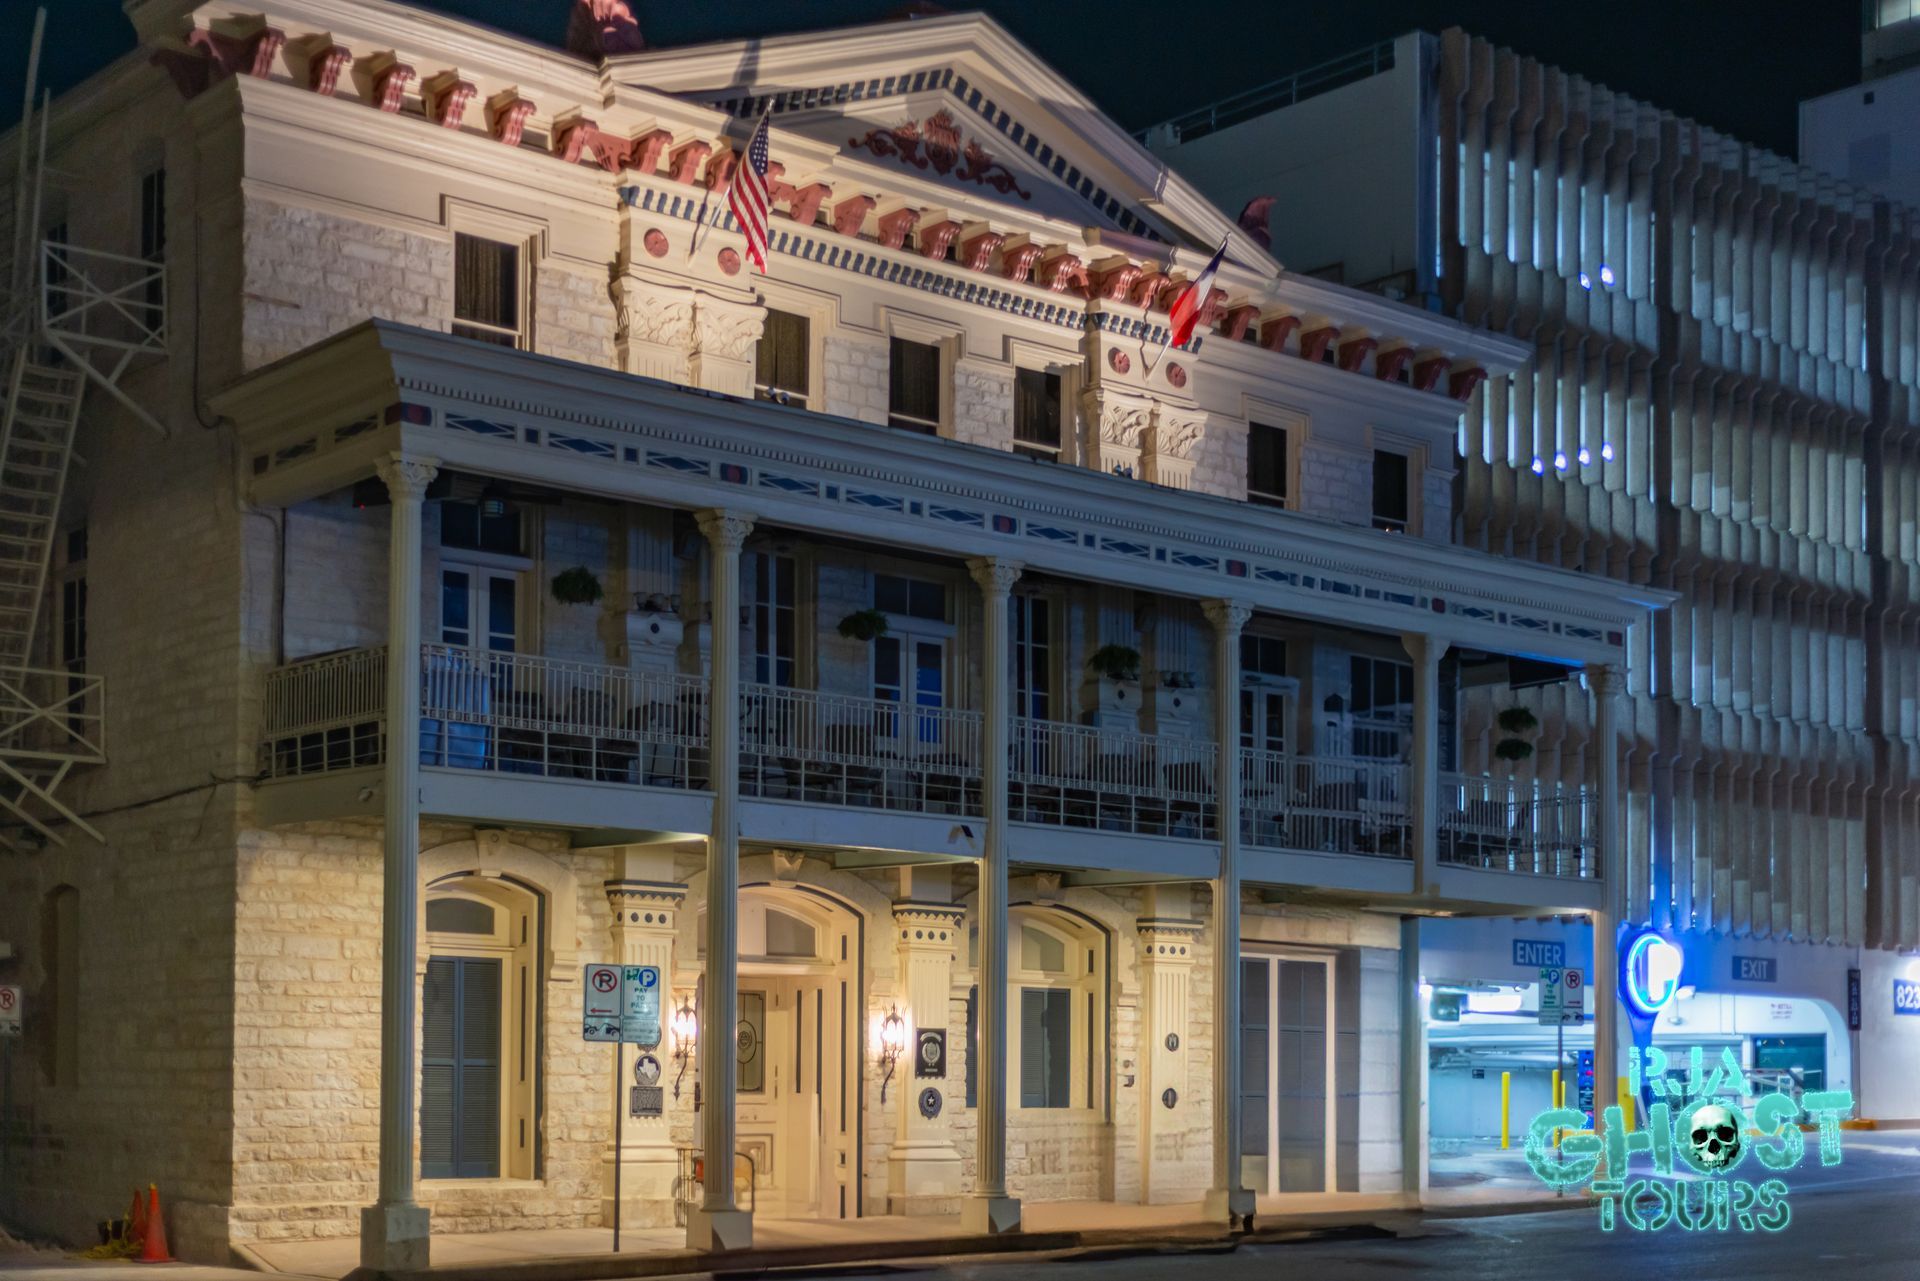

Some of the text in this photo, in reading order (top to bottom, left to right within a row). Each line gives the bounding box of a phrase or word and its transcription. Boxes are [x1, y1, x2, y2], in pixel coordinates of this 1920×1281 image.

[1516, 942, 1562, 966] ENTER
[1741, 959, 1769, 979] EXIT
[1896, 985, 1920, 1008] 823
